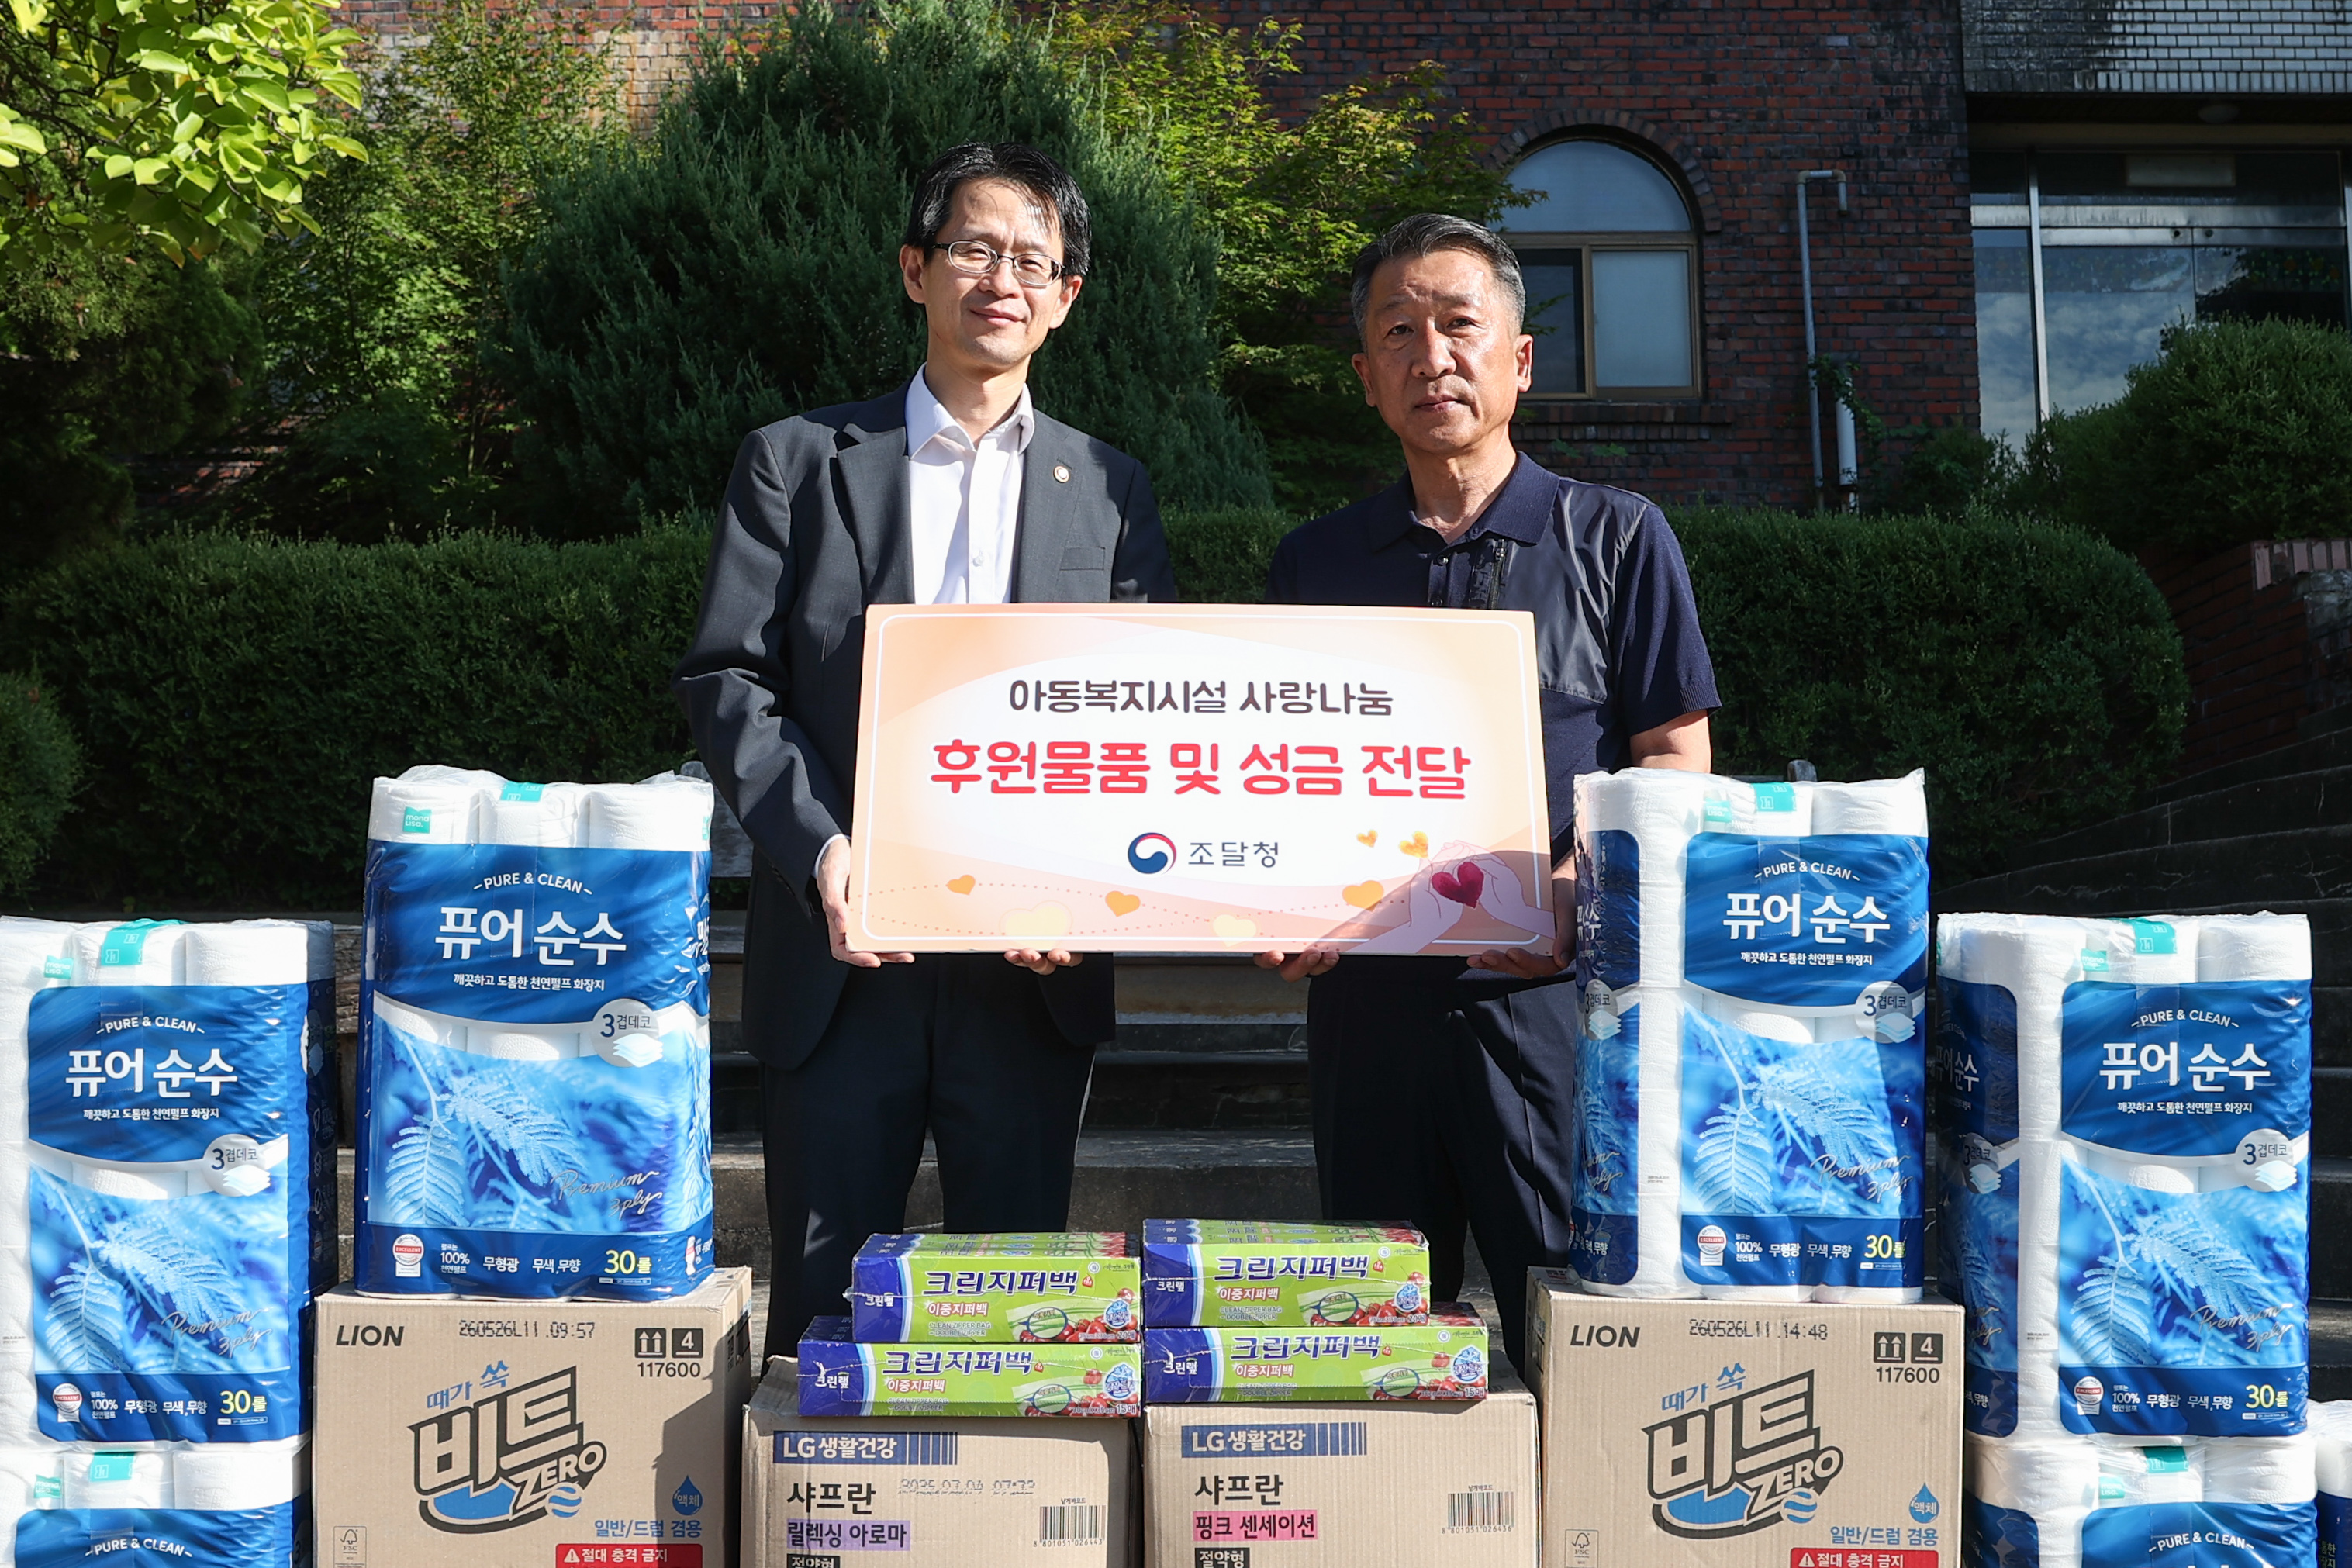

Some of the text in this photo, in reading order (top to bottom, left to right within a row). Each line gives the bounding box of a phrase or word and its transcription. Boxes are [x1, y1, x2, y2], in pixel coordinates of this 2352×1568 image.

[1008, 679, 1394, 716] 아동복지시설 사랑나눔
[931, 738, 1471, 800] 후원물품 및 성금 전달
[1188, 841, 1280, 869] 조달청
[1763, 862, 1851, 879] PURE & CLEAN
[484, 872, 583, 894] PURE & CLEAN
[1723, 893, 1891, 944] 퓨어 순수
[435, 907, 627, 966] 퓨어 순수
[1740, 952, 1873, 966] 깨끗하고 도톰한 천연펄프 화장지
[454, 974, 605, 992] 깨끗하고 도톰한 천연펄프 화장지
[1863, 994, 1907, 1017] 3겹데코
[105, 1016, 197, 1033] PURE & CLEAN
[600, 1014, 651, 1038] 3겹데코
[2140, 1010, 2230, 1027] PURE & CLEAN
[65, 1048, 237, 1098] 퓨어 순수
[2099, 1042, 2271, 1092] 퓨어 순수
[84, 1108, 219, 1121] 깨끗하고 도톰한 천연펄프 화장지
[2117, 1102, 2253, 1115] 깨끗하고 도톰한 천연펄프 화장지
[211, 1148, 257, 1170] 3겹데코
[2243, 1143, 2287, 1166] 3겹데코
[1811, 1153, 1911, 1183] Premium
[550, 1169, 661, 1200] Premium
[1867, 1173, 1912, 1200] 3ply
[608, 1190, 663, 1220] 3ply
[440, 1252, 470, 1265] 100%
[1735, 1242, 1763, 1253] 100%
[1769, 1243, 1800, 1258] 무형광
[483, 1256, 520, 1273] 무형광
[604, 1249, 652, 1274] 30롤
[1218, 1287, 1280, 1301] 이중지퍼백
[927, 1302, 989, 1316] 이중지퍼백
[2190, 1303, 2293, 1331] Premium
[161, 1307, 272, 1340] Premium
[219, 1328, 272, 1357] 3ply
[336, 1325, 405, 1347] LION
[680, 1331, 695, 1349] 4
[1570, 1325, 1640, 1348] LION
[1919, 1336, 1935, 1354] 4
[2246, 1322, 2294, 1352] 3ply
[637, 1363, 701, 1378] 117600
[1235, 1363, 1293, 1377] 이중지퍼백
[1876, 1368, 1940, 1384] 117600
[426, 1360, 510, 1411] 때가 쏙
[887, 1379, 945, 1393] 이중지퍼백
[1661, 1363, 1746, 1412] 때가 쏙
[2146, 1394, 2181, 1408] 무형광
[2245, 1384, 2288, 1409] 30롤
[91, 1399, 118, 1411] 100%
[124, 1400, 157, 1414] 무형광
[220, 1390, 268, 1414] 30롤
[1117, 1404, 1137, 1414] 15매
[2112, 1393, 2140, 1404] 100%
[413, 1367, 582, 1493] 비트
[1647, 1371, 1818, 1498] 비트
[513, 1445, 606, 1510] ZERO
[1748, 1449, 1843, 1515] ZERO
[677, 1494, 699, 1507] 액체
[787, 1481, 876, 1514] 샤프란
[1194, 1474, 1283, 1506] 샤프란
[1914, 1501, 1937, 1514] 액체
[594, 1520, 703, 1538] 일반/드럼 겸용
[787, 1521, 907, 1549] 릴렉싱 아로마
[1196, 1513, 1315, 1540] 핑크 센세이션
[1830, 1526, 1939, 1546] 일반/드럼 겸용
[94, 1539, 185, 1556] PURE & CLEAN
[2157, 1532, 2246, 1551] PURE & CLEAN
[582, 1549, 668, 1563] 절대 충격 금지
[1199, 1550, 1245, 1568] 절약형
[1816, 1553, 1904, 1567] 절대 충격 금지
